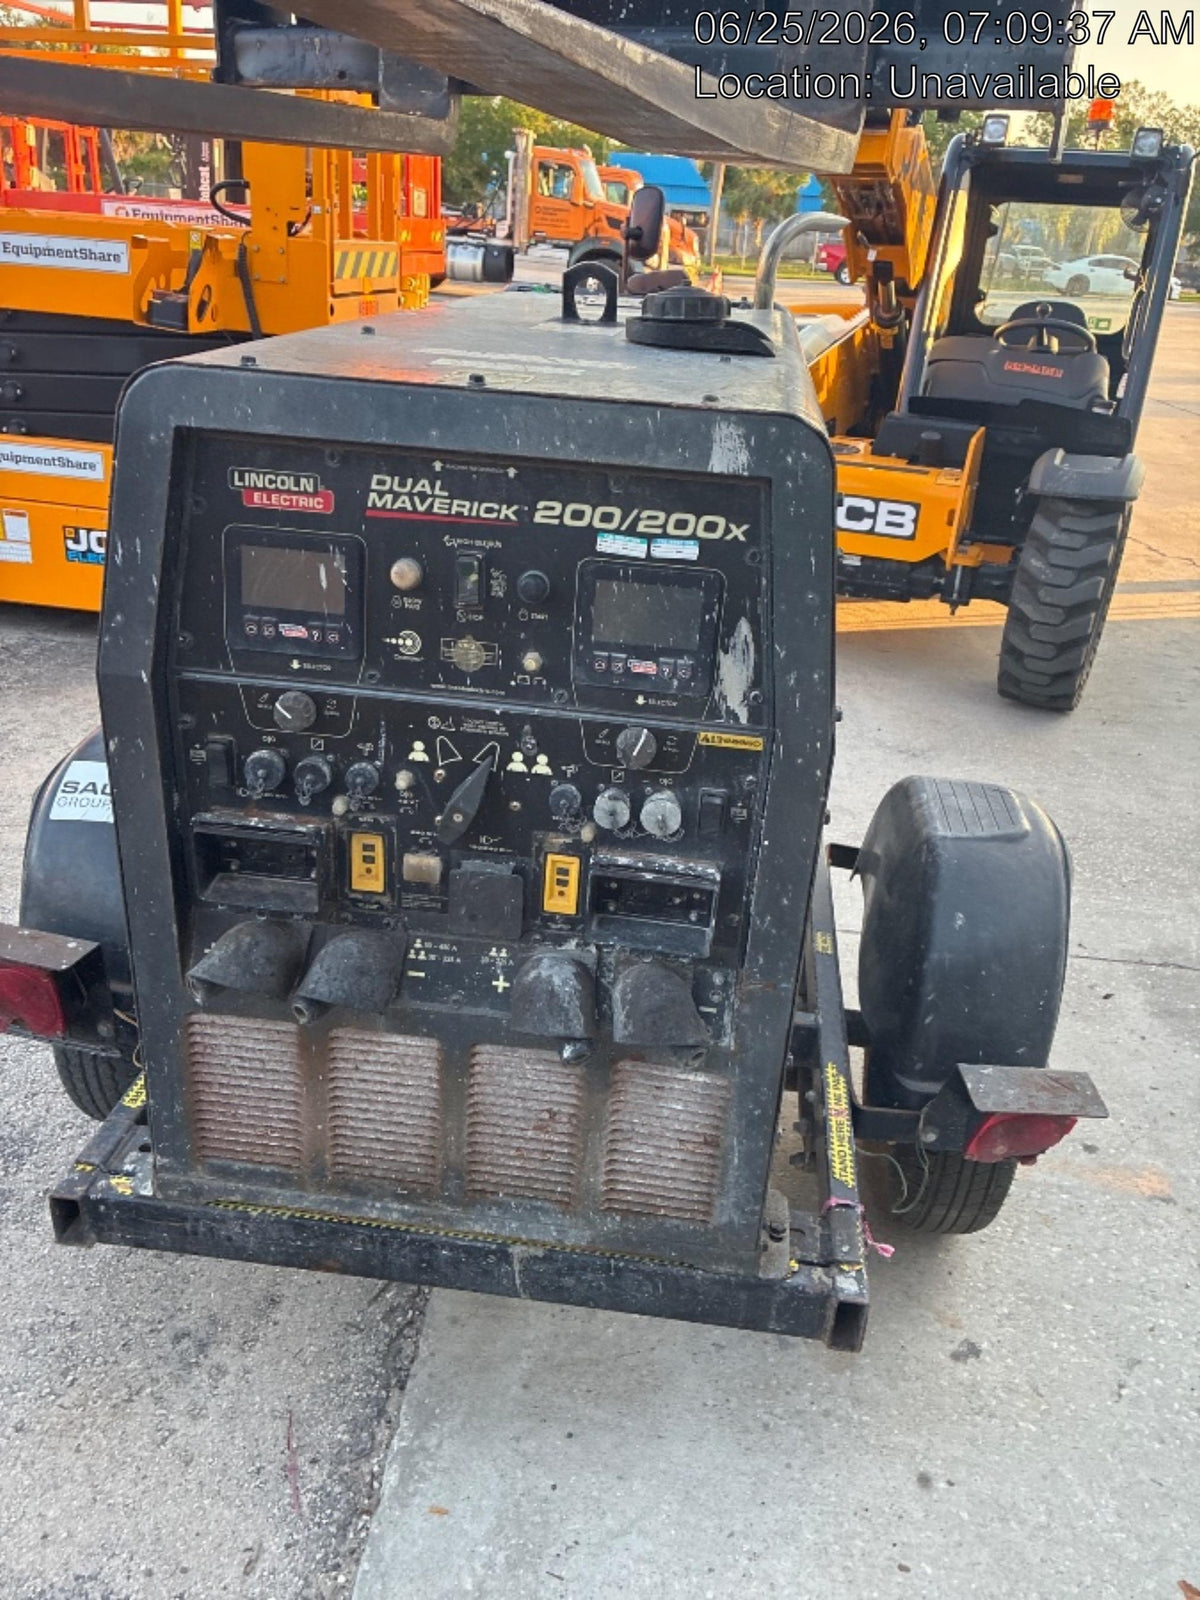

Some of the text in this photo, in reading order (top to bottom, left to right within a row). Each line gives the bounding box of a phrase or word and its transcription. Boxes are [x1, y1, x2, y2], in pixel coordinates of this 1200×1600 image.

[199, 166, 210, 202] obcat
[2, 241, 121, 263] EquipmentShare
[0, 451, 97, 471] uipmentShare
[233, 471, 314, 493] LINCOLN
[370, 474, 449, 497] DUAL
[253, 491, 325, 510] ELECTRIC
[367, 492, 750, 542] MAVERICK 200/200x
[837, 497, 917, 537] CB
[66, 529, 107, 554] JC
[837, 1149, 849, 1178] TAND
